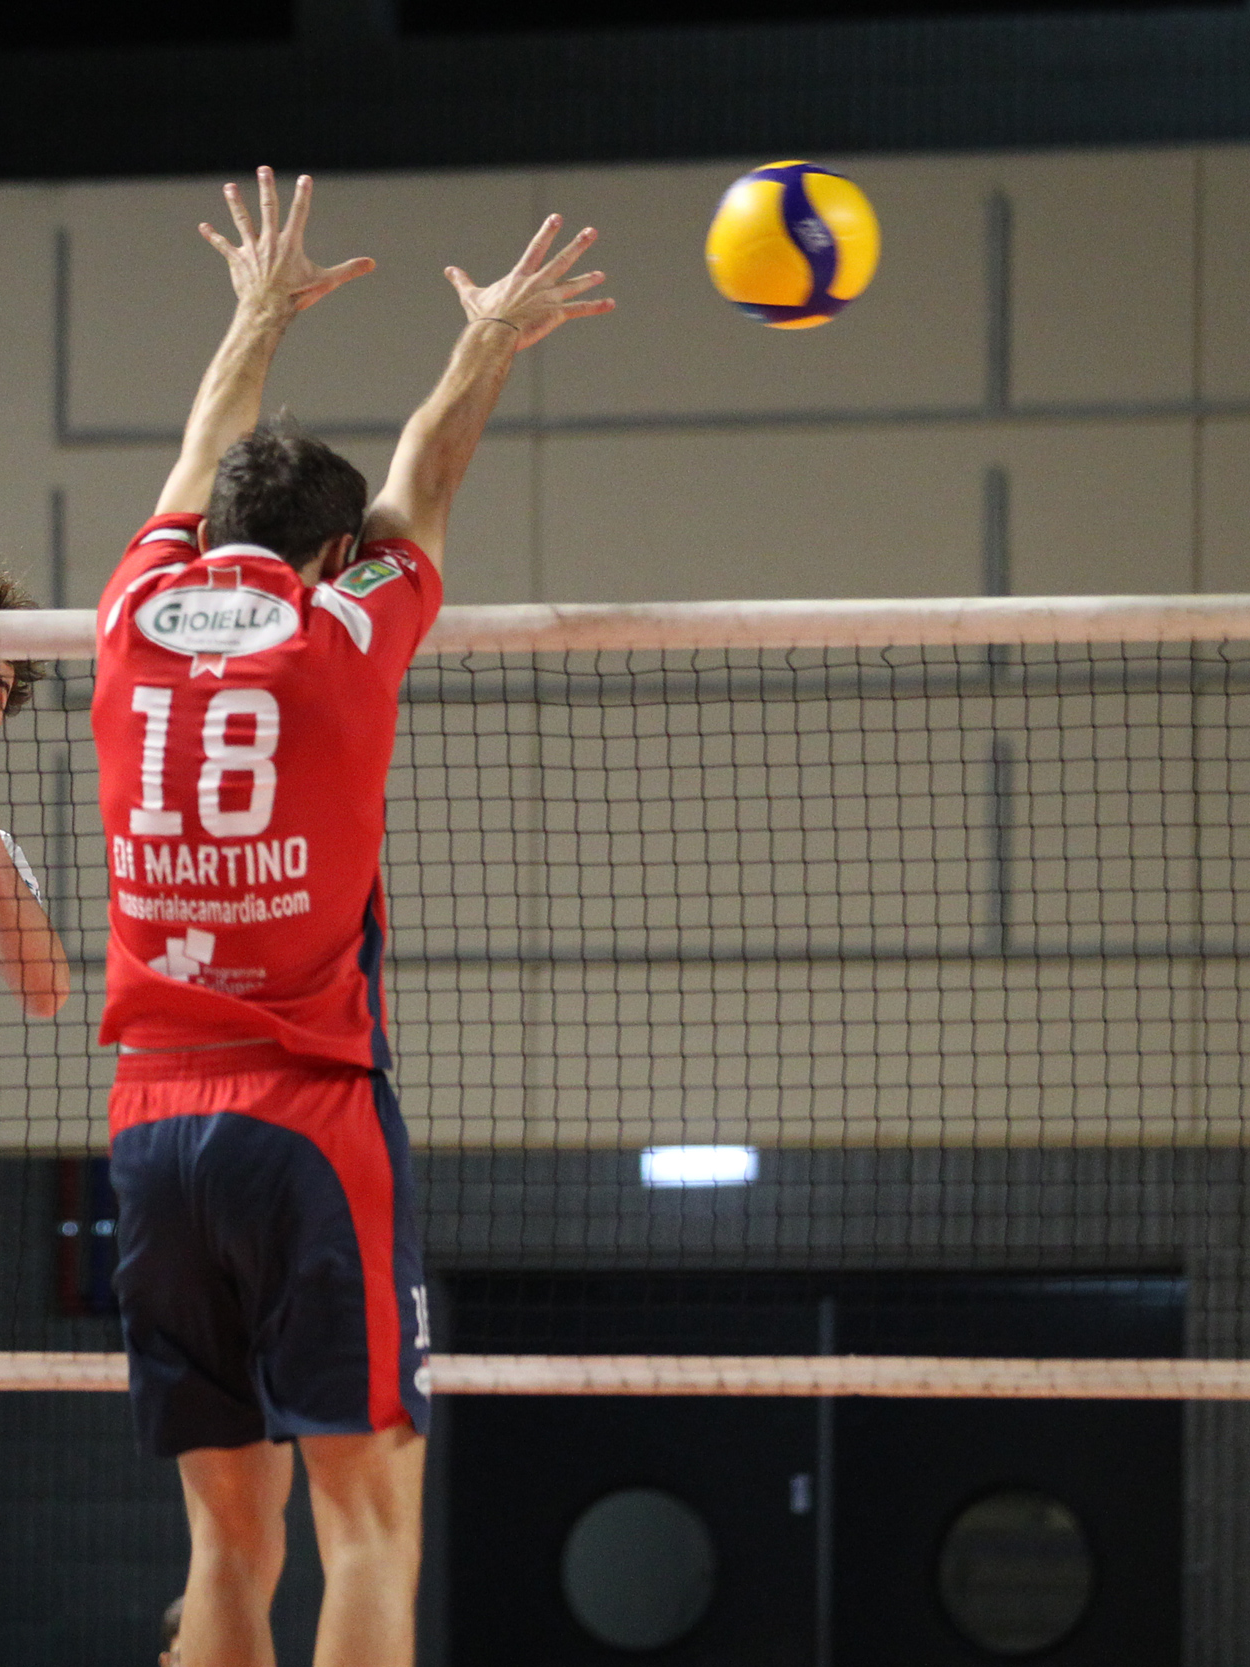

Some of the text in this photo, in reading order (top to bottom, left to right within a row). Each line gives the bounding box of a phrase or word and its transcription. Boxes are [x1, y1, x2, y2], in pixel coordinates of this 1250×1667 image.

[153, 602, 282, 634] GIOIELLA
[129, 686, 281, 838] 18
[143, 836, 308, 887] MARTINO
